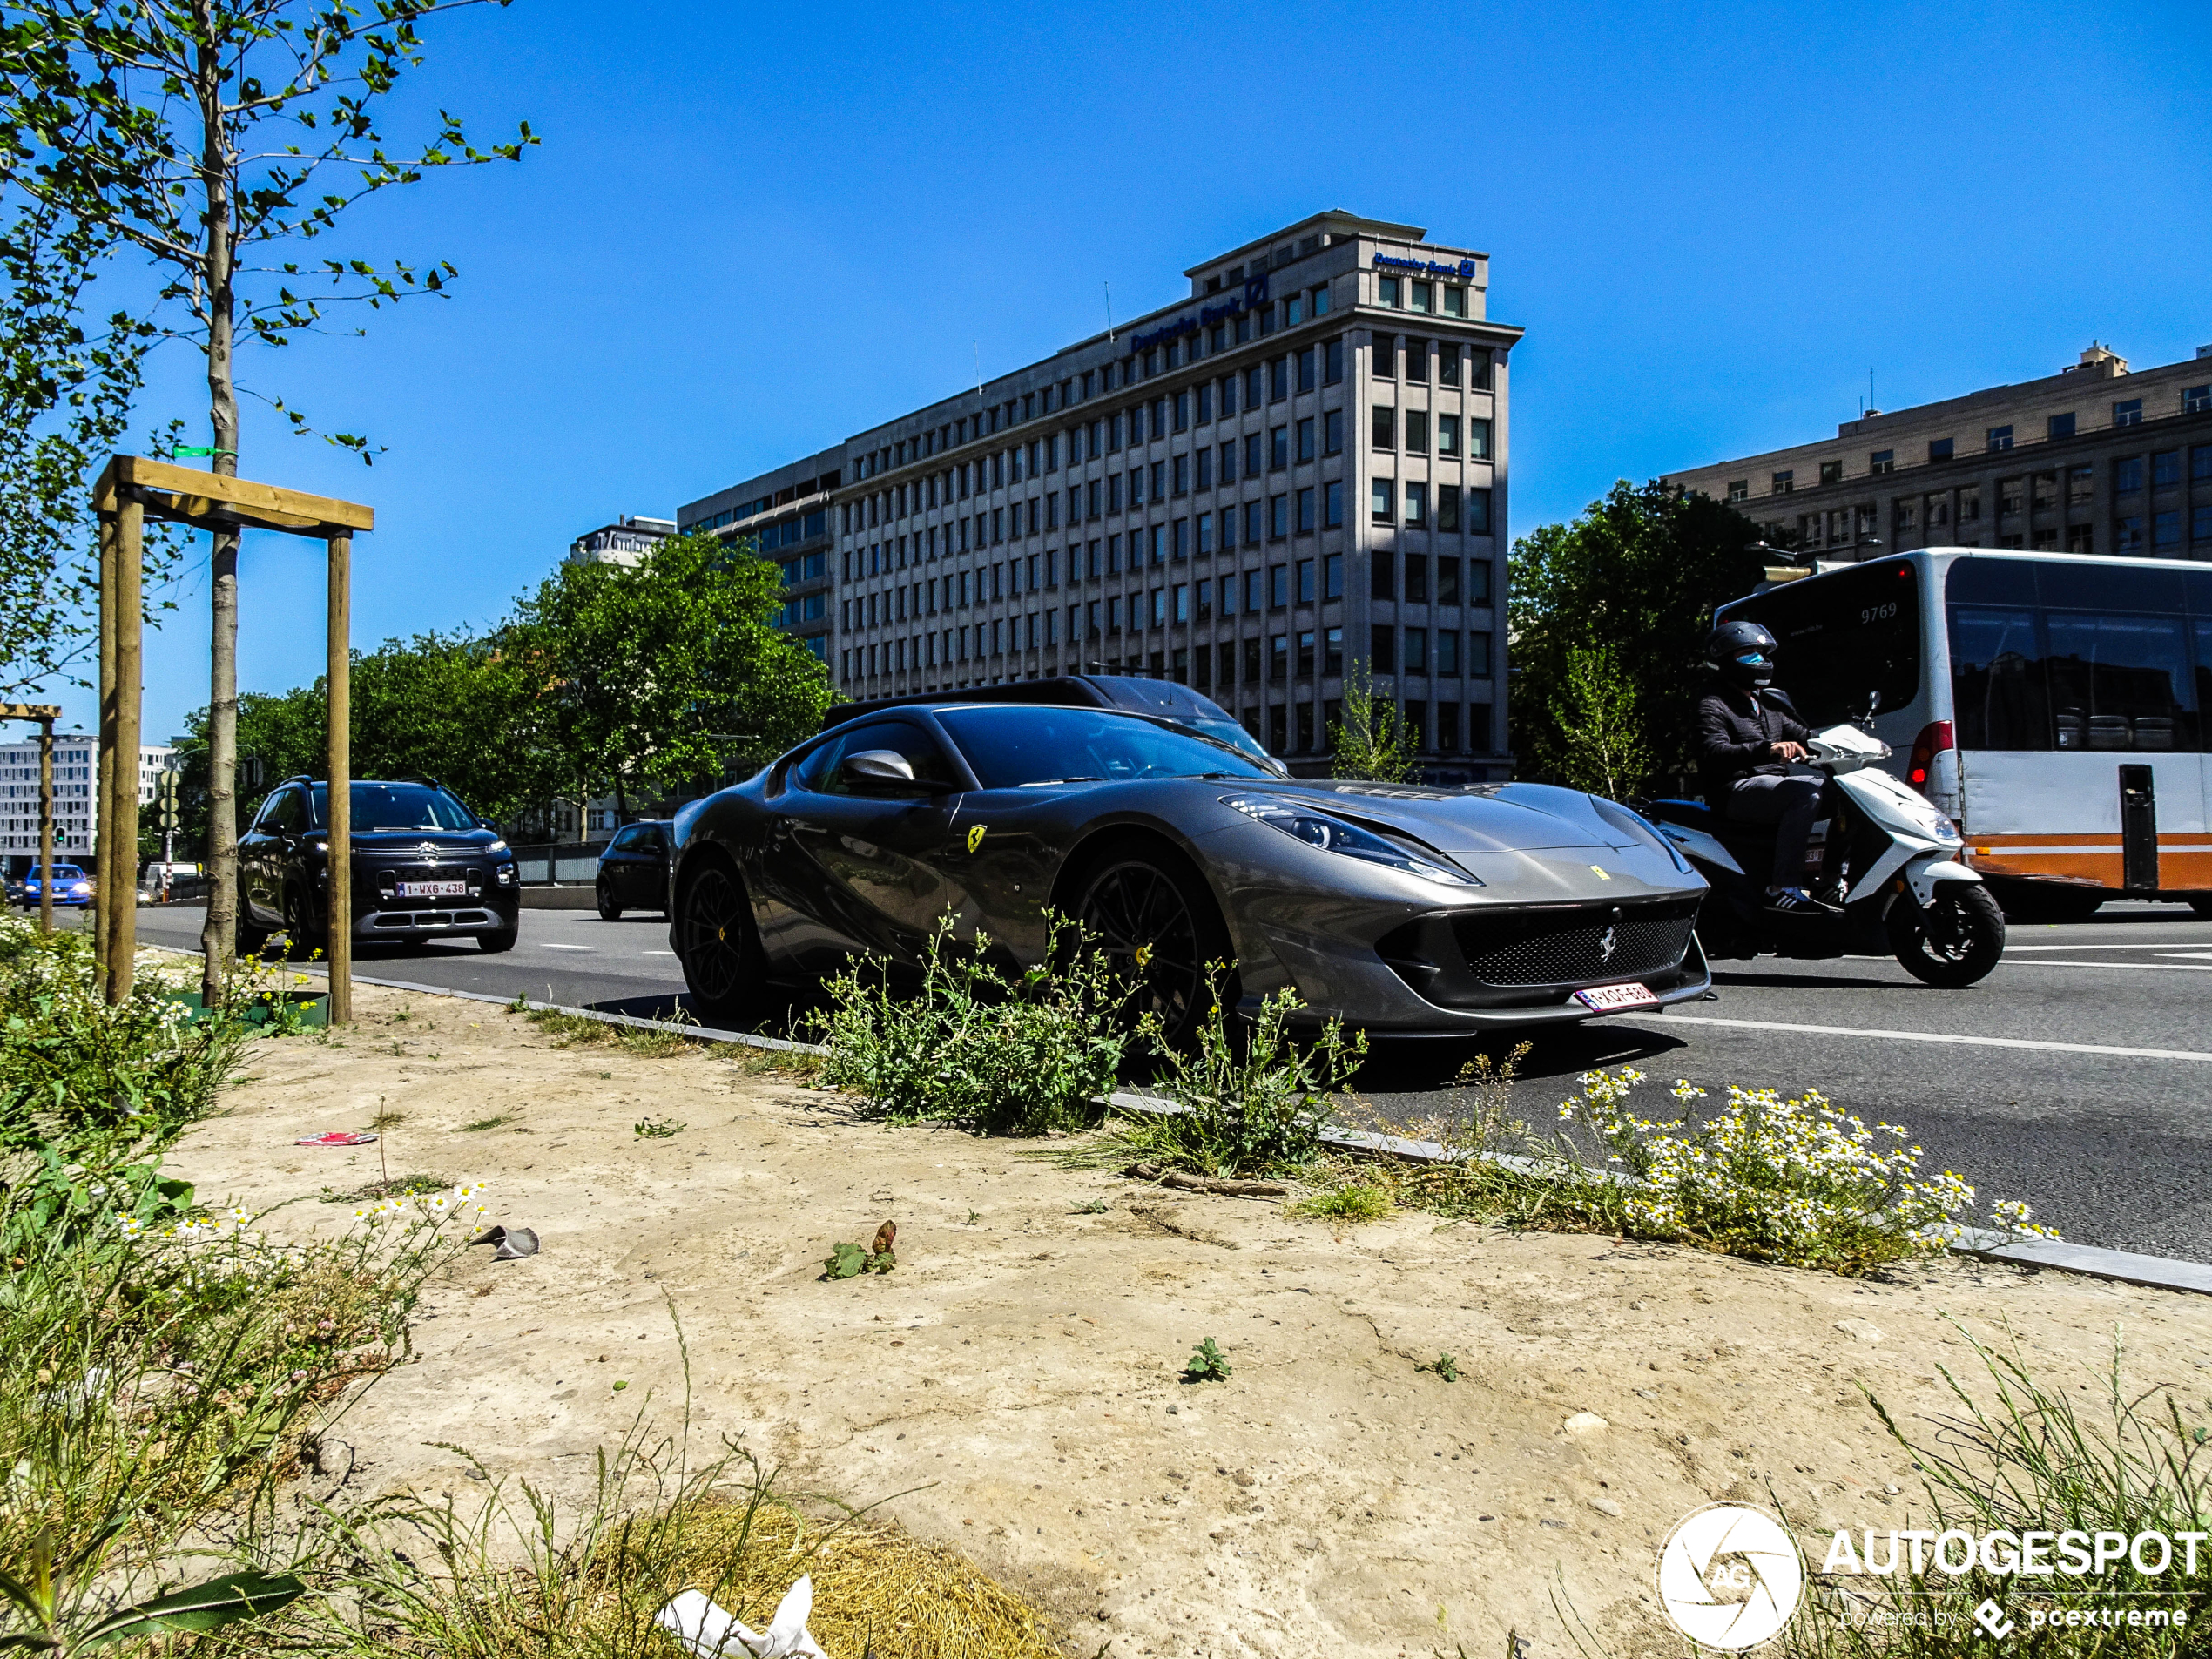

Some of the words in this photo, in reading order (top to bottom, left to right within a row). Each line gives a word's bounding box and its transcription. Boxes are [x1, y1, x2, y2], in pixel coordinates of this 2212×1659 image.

[1374, 252, 1426, 270] Deutsche
[1428, 260, 1456, 275] Bank
[1131, 316, 1197, 353] Deutsche
[1201, 297, 1240, 327] Bank
[1861, 602, 1897, 624] 9769
[407, 883, 464, 894] 1-WXG-438
[1590, 987, 1652, 1005] 1-XQF-680
